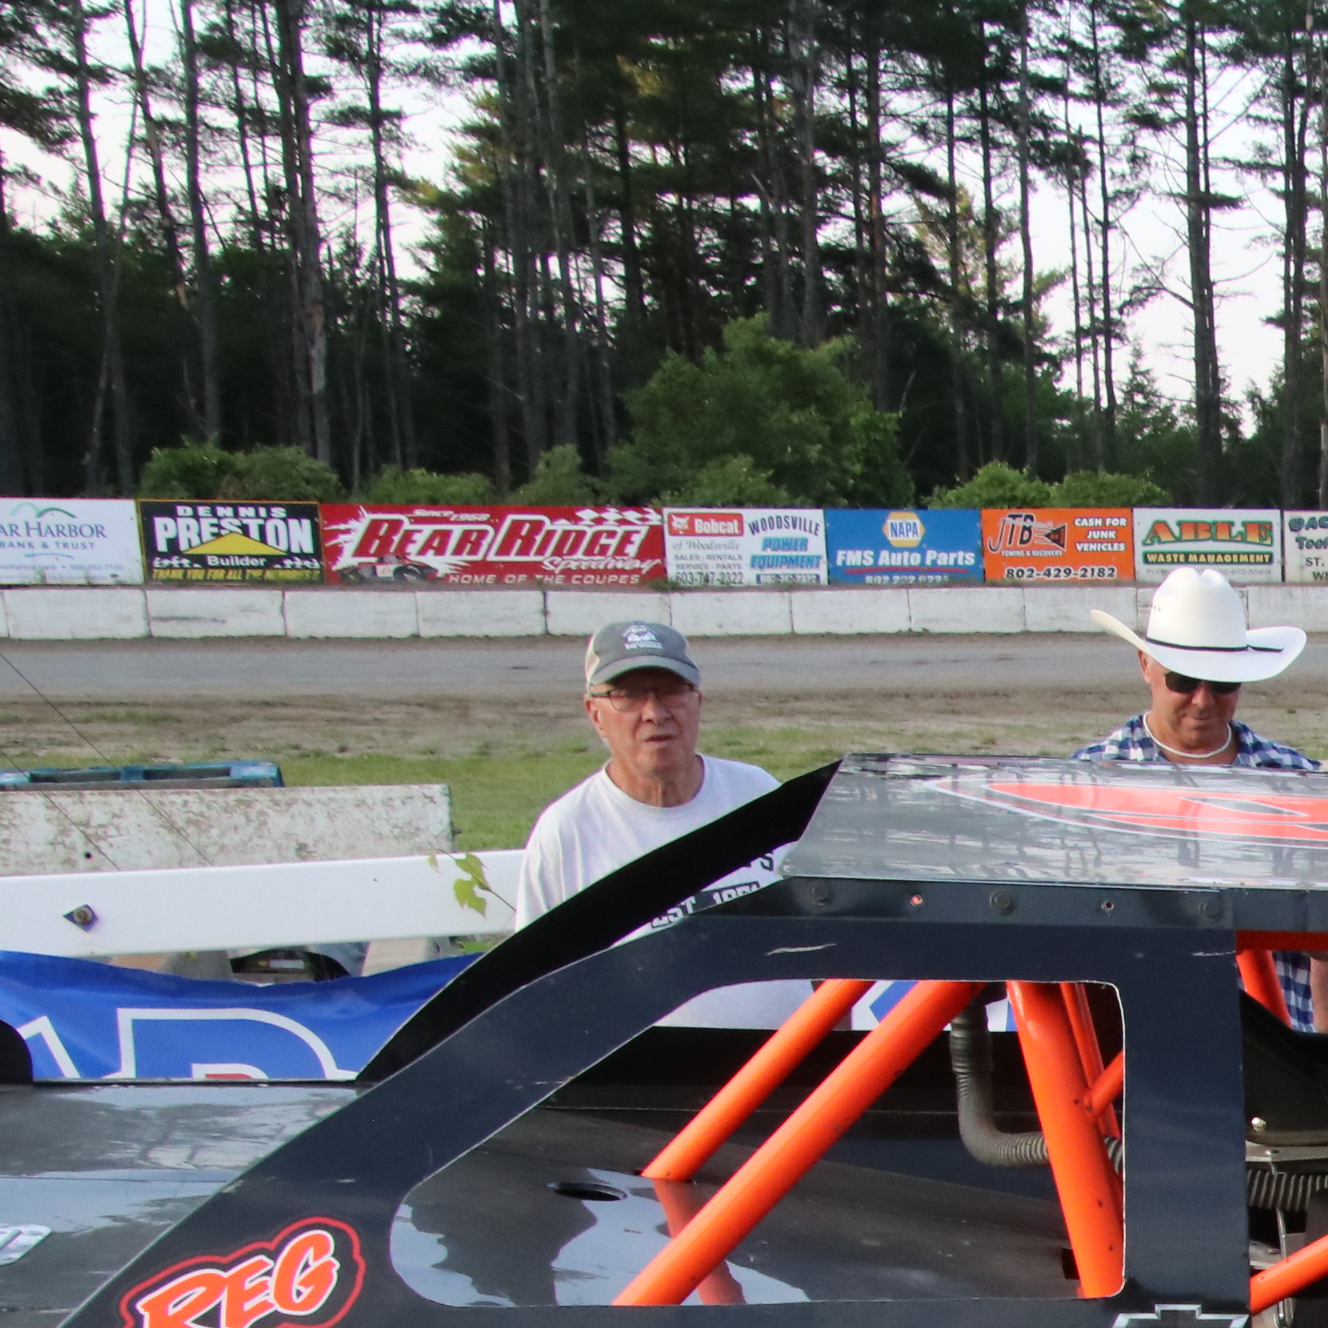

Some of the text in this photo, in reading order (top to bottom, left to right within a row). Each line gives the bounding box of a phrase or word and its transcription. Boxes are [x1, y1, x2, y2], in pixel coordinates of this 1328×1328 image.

[175, 505, 288, 518] DENNIS
[693, 517, 740, 535] Bobcat
[748, 514, 821, 537] WOODSVILLE
[1074, 517, 1128, 527] CASH FOR
[25, 521, 107, 538] HARBOR
[153, 516, 315, 555] PRESTON
[890, 521, 920, 538] NAPA
[987, 512, 1037, 554] JTB
[1086, 530, 1117, 540] JUNK
[1142, 519, 1274, 547] ABLE
[350, 514, 650, 562] BEAR RIDGE
[761, 537, 809, 551] POWER
[1295, 536, 1328, 550] Tool
[41, 541, 50, 549] &
[55, 541, 96, 550] TRUST
[1075, 542, 1127, 552] VEHICLES
[207, 555, 267, 567] Builder
[750, 555, 823, 569] EQUIPMENT
[836, 550, 976, 567] FMS Auto Parts
[1146, 553, 1271, 563] WASTE MANAGEMENT
[1305, 557, 1325, 567] ST.
[448, 573, 641, 585] HOME OF THE COUPES
[1004, 566, 1118, 580] 802-429-2182
